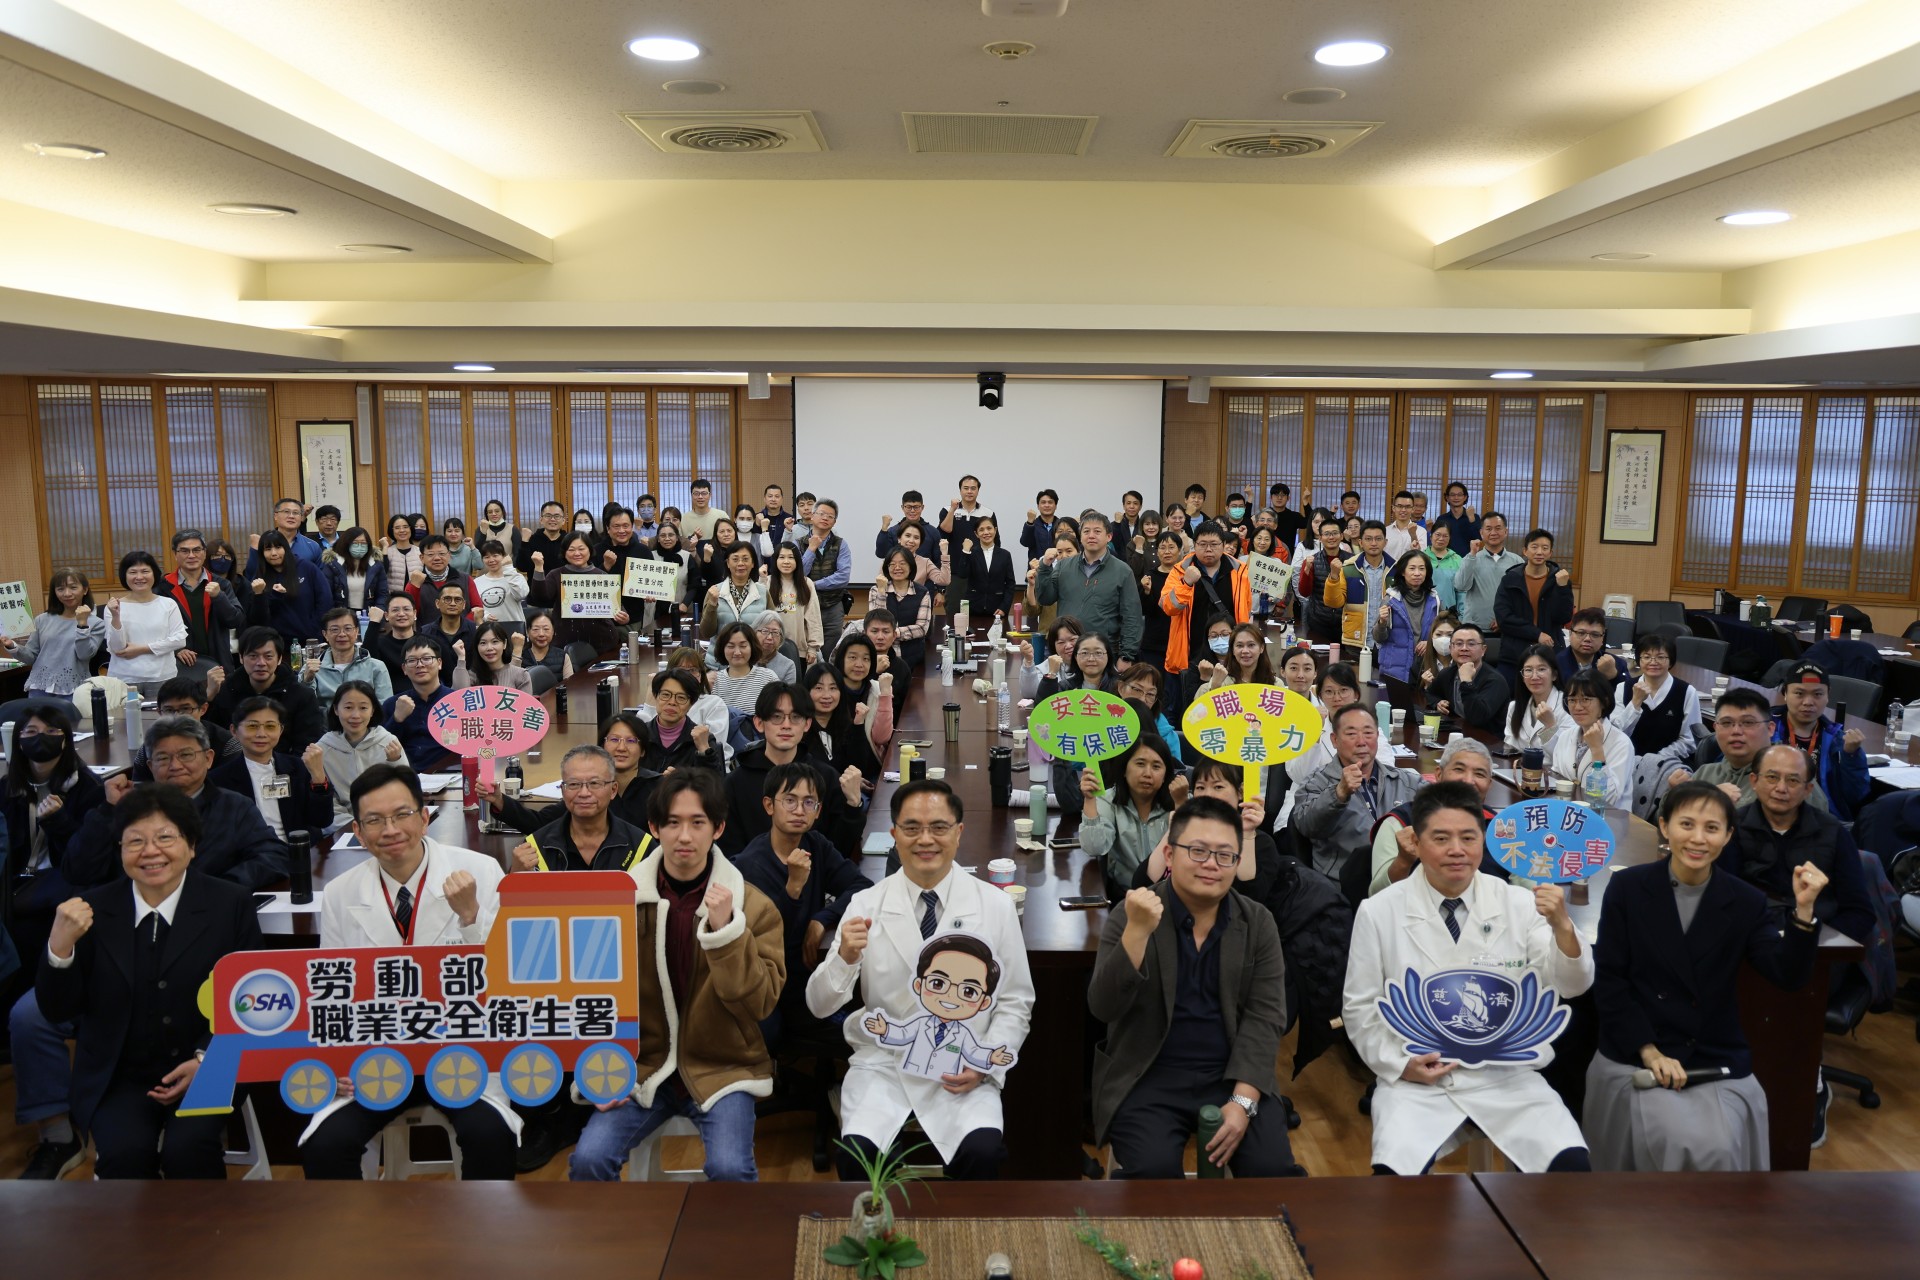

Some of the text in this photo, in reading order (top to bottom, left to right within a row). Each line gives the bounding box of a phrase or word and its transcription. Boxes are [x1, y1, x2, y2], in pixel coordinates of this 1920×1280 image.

[629, 562, 675, 575] 臺北榮民總醫院
[638, 578, 663, 587] 玉里分院
[432, 687, 545, 731] 共創友善
[1050, 694, 1101, 721] 安全
[1211, 688, 1285, 718] 職場
[460, 717, 514, 741] 職場
[1056, 724, 1132, 757] 有保障
[1200, 724, 1305, 763] 零暴力
[1524, 805, 1587, 834] 預防
[1501, 839, 1608, 877] 不法侵害
[310, 957, 486, 999] 勞動部
[234, 992, 294, 1013] OSHA
[311, 998, 615, 1043] 職業安全衛生署
